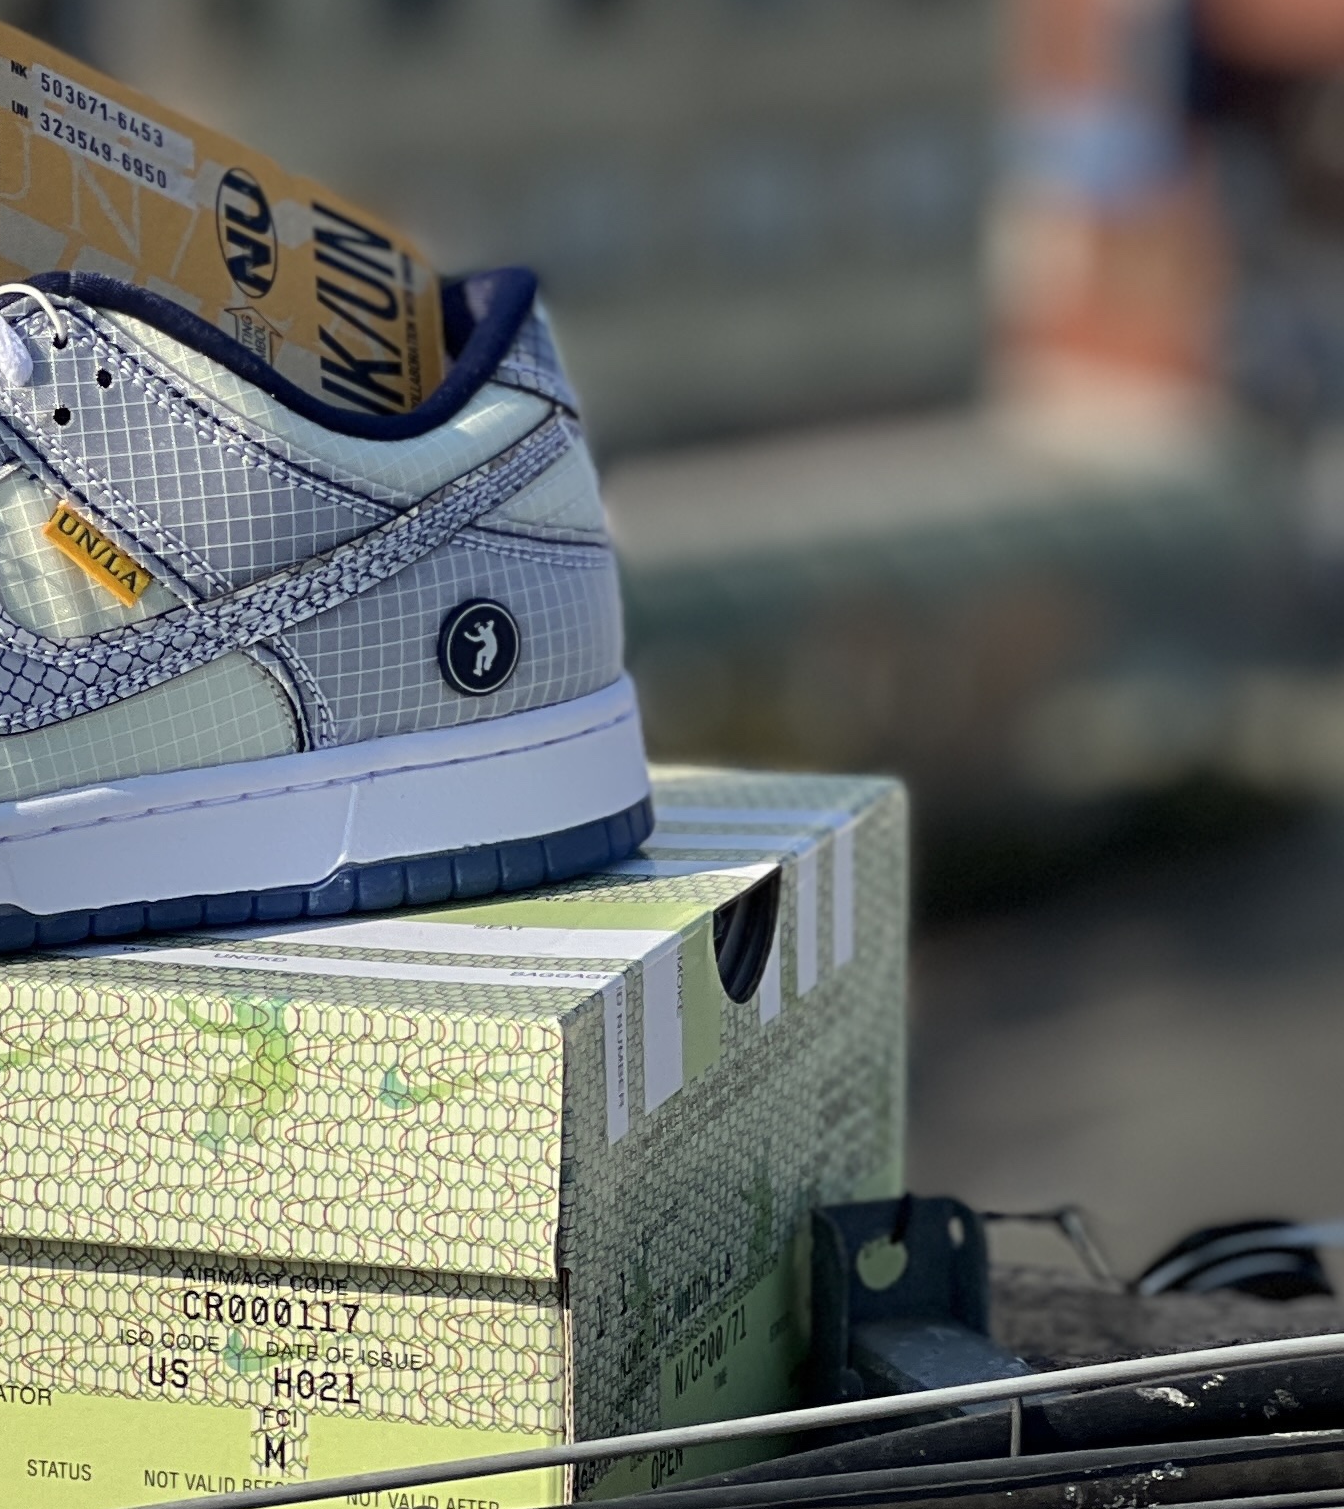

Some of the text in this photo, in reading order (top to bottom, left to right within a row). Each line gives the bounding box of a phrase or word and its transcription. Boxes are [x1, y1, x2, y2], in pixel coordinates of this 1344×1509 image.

[10, 59, 164, 148] NK 503671-6453
[11, 99, 167, 189] UN 323549-6950
[57, 512, 138, 594] UN/LA
[289, 1273, 349, 1297] CODE
[182, 1290, 361, 1334] CR000117
[119, 1327, 221, 1352] ISO CODE
[265, 1340, 424, 1372] DATE OF ISSUE
[147, 1355, 190, 1389] US
[273, 1366, 361, 1405] H021
[262, 1407, 297, 1429] FCI
[264, 1434, 287, 1470] M
[26, 1458, 92, 1482] STATUS
[143, 1469, 180, 1490] NOT
[184, 1472, 236, 1494] VALID
